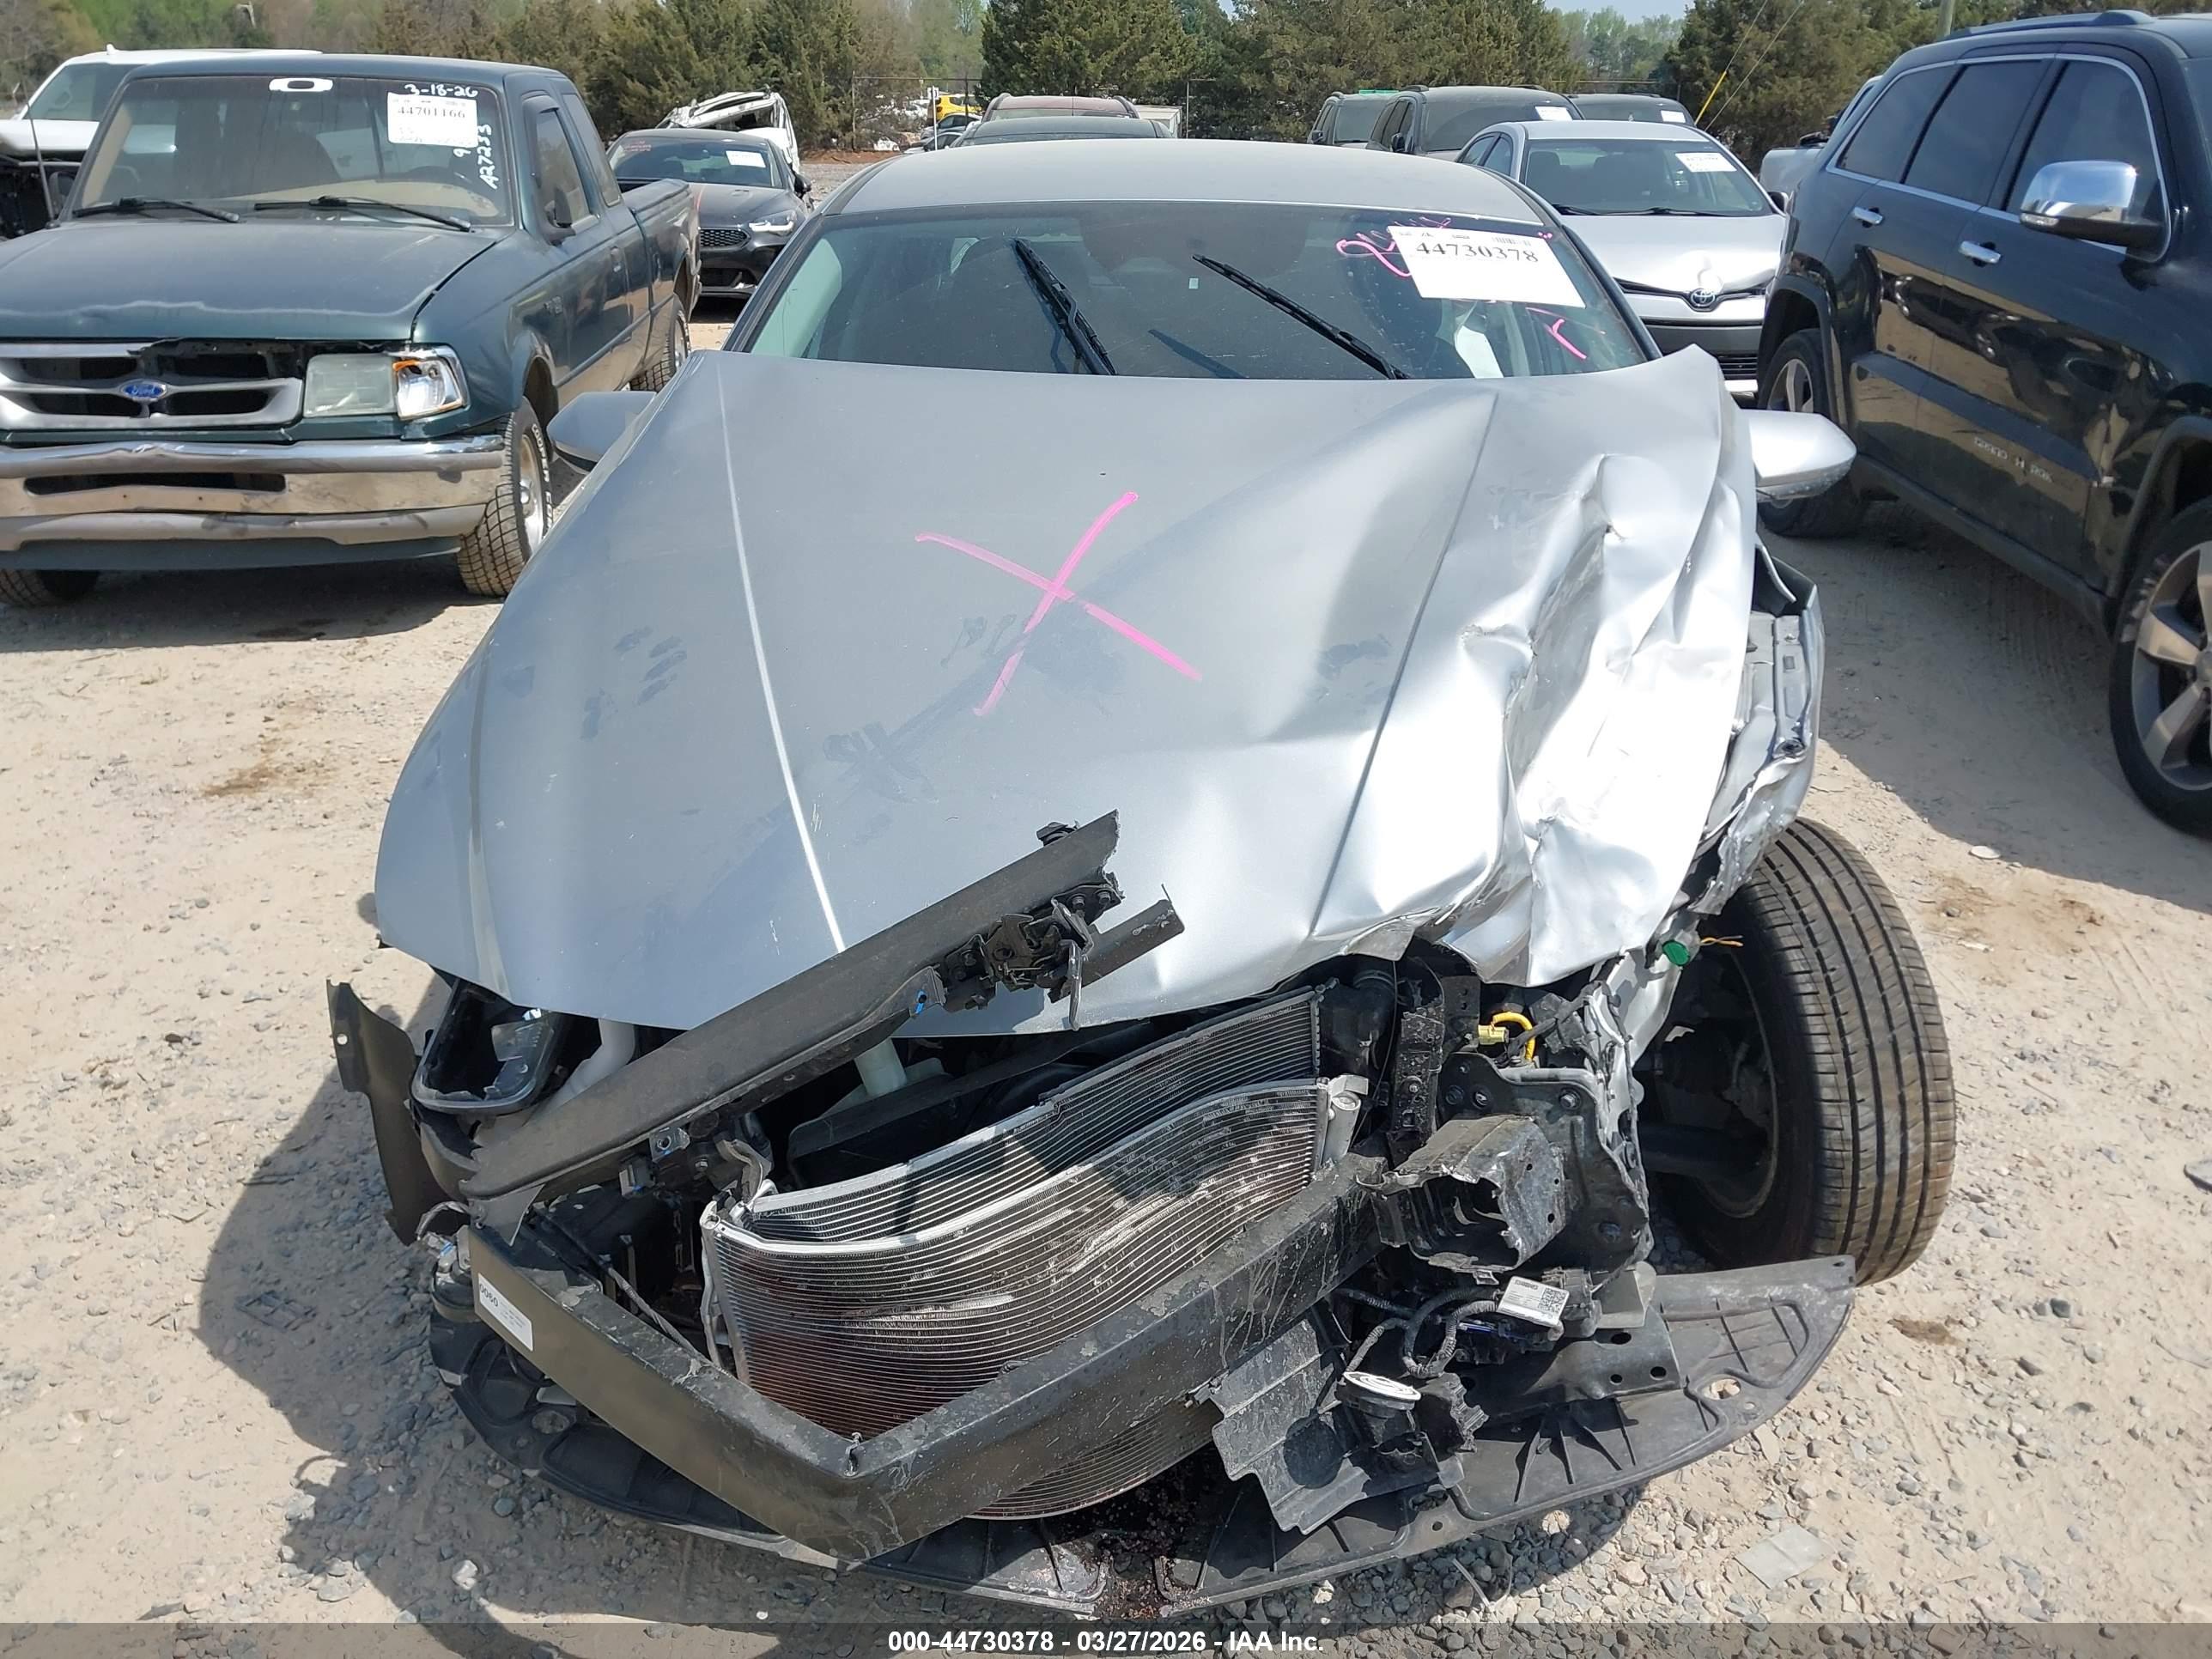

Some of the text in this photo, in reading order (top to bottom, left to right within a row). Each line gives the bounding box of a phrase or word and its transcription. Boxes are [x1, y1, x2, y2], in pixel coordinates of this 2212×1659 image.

[404, 83, 478, 98] 3-18-26
[398, 106, 465, 118] 44701166
[1416, 242, 1539, 263] 44730378
